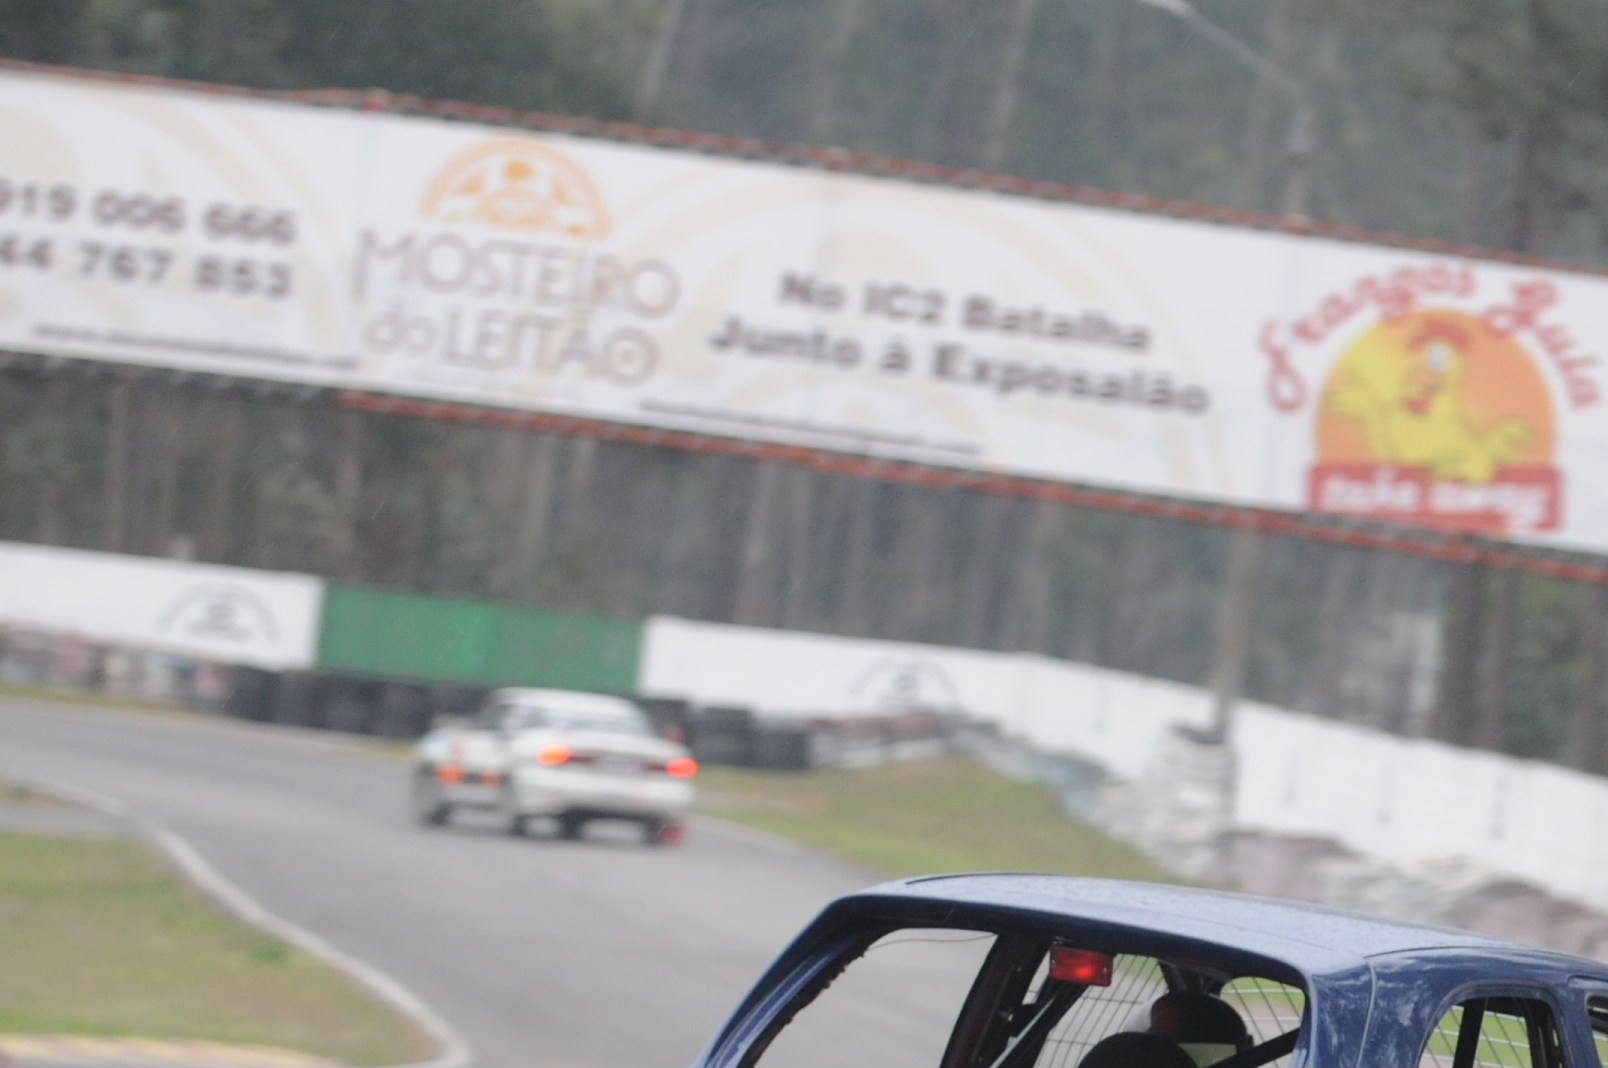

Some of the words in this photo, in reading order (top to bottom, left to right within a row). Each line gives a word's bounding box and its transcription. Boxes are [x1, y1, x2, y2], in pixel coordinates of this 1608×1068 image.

[77, 242, 175, 285] 767
[204, 203, 298, 246] 666
[352, 226, 681, 318] MOSTEIRO
[780, 272, 845, 313] No
[862, 280, 945, 327] IC2
[962, 294, 1151, 353] Batalha
[710, 317, 862, 368] Junto
[931, 343, 1211, 416] Exposalão
